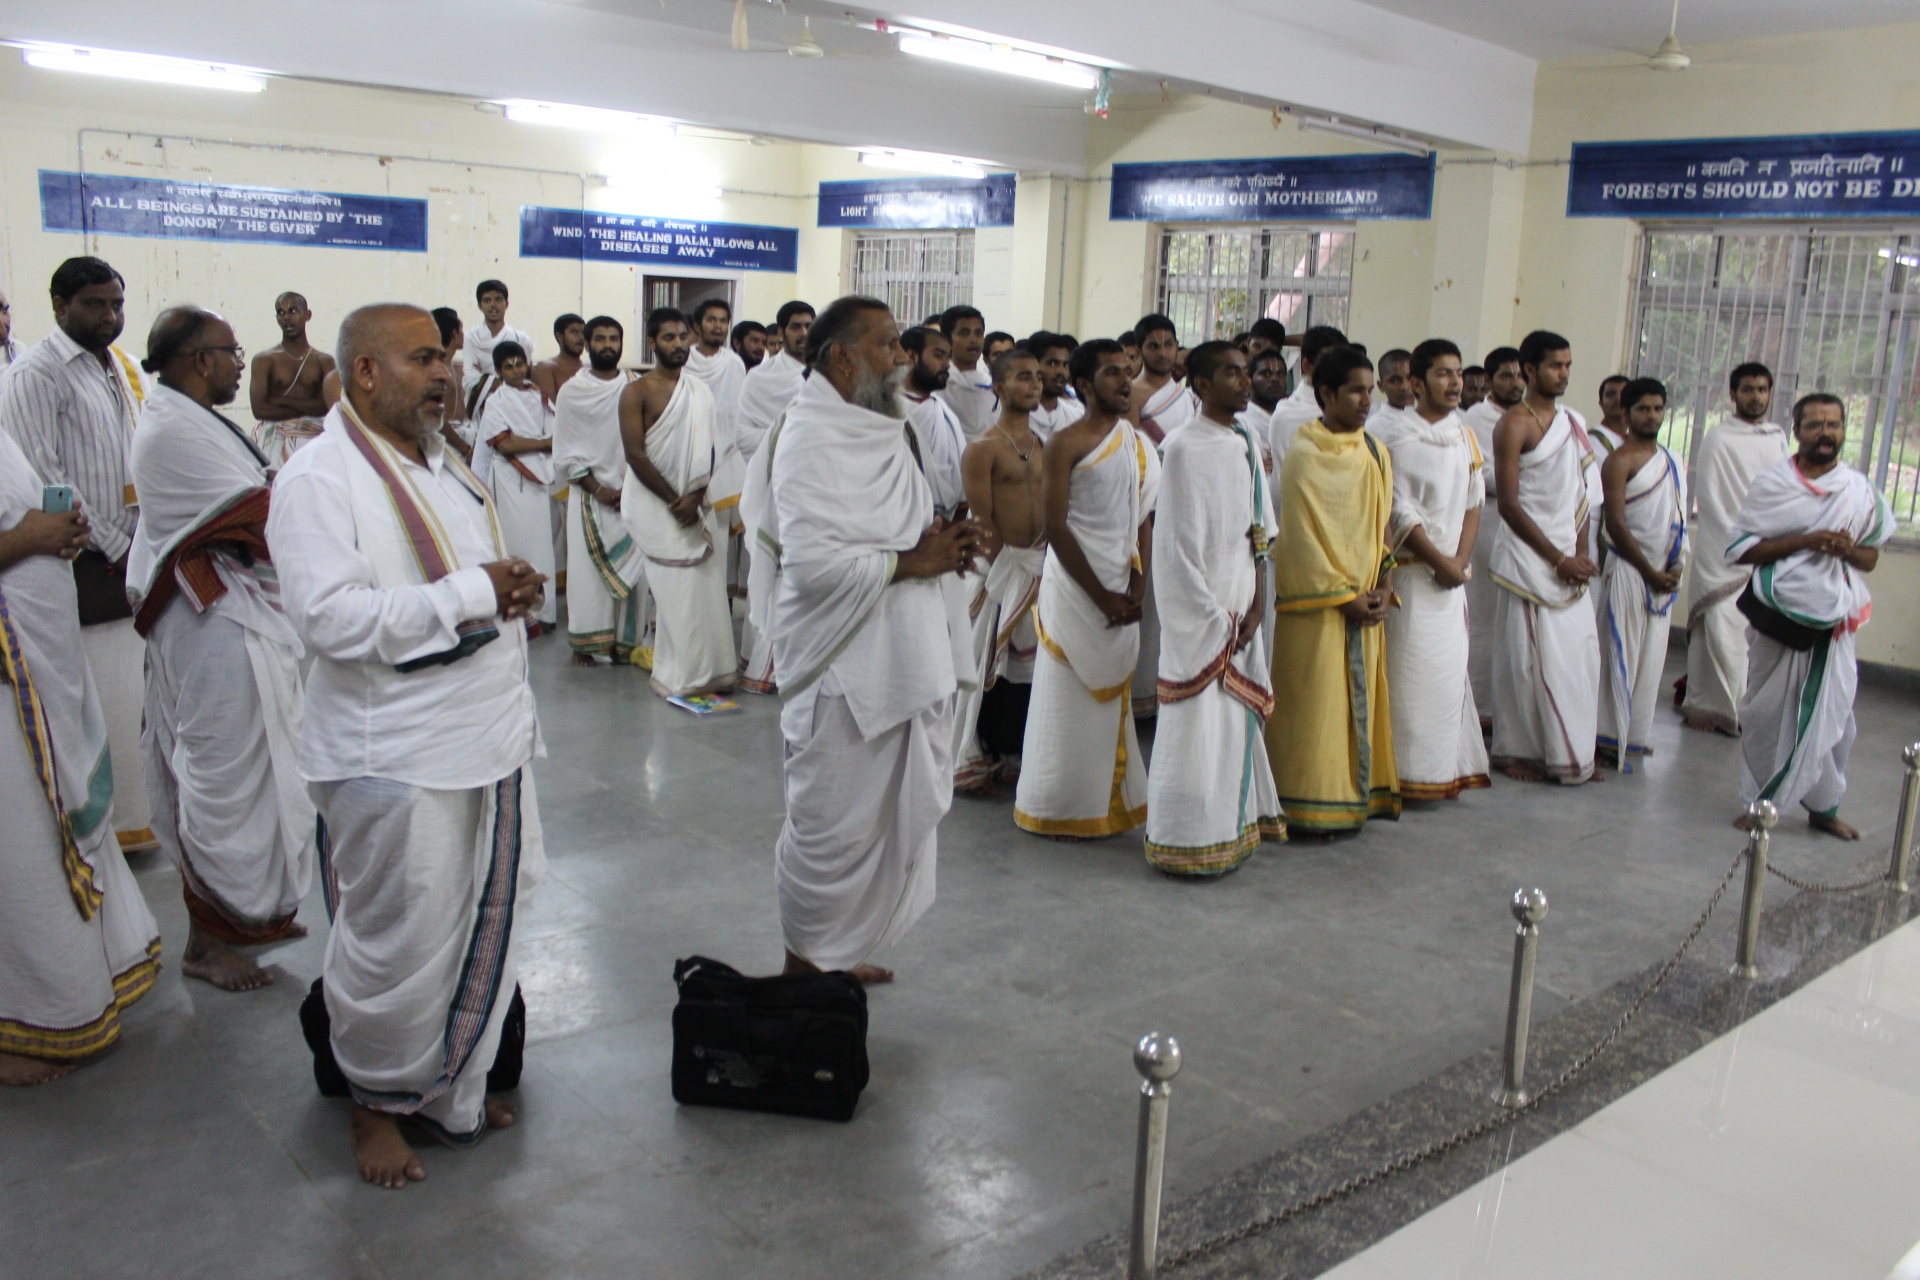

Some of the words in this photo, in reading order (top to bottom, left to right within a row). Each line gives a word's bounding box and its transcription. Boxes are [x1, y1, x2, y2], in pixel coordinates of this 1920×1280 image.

[1140, 192, 1163, 207] WE
[1167, 191, 1225, 207] SALUTE
[1229, 191, 1259, 206] OUR
[1264, 190, 1378, 206] MOTHERLAND
[1602, 182, 1697, 200] FORESTS
[1702, 180, 1789, 200] SHOULD
[1794, 180, 1839, 199] NOT
[1844, 178, 1882, 199] BE
[90, 196, 132, 210] ALL
[136, 200, 205, 215] BEINGS
[207, 204, 239, 217] ARE
[240, 206, 324, 223] SUSTAINED
[326, 211, 345, 224] BY
[840, 205, 868, 217] LIGHT
[589, 227, 617, 240] THE
[620, 230, 672, 244] HEALING
[713, 236, 755, 250] BLOWS
[757, 240, 778, 252] ALL
[600, 240, 669, 255] DISEASES
[677, 245, 716, 258] AWAY
